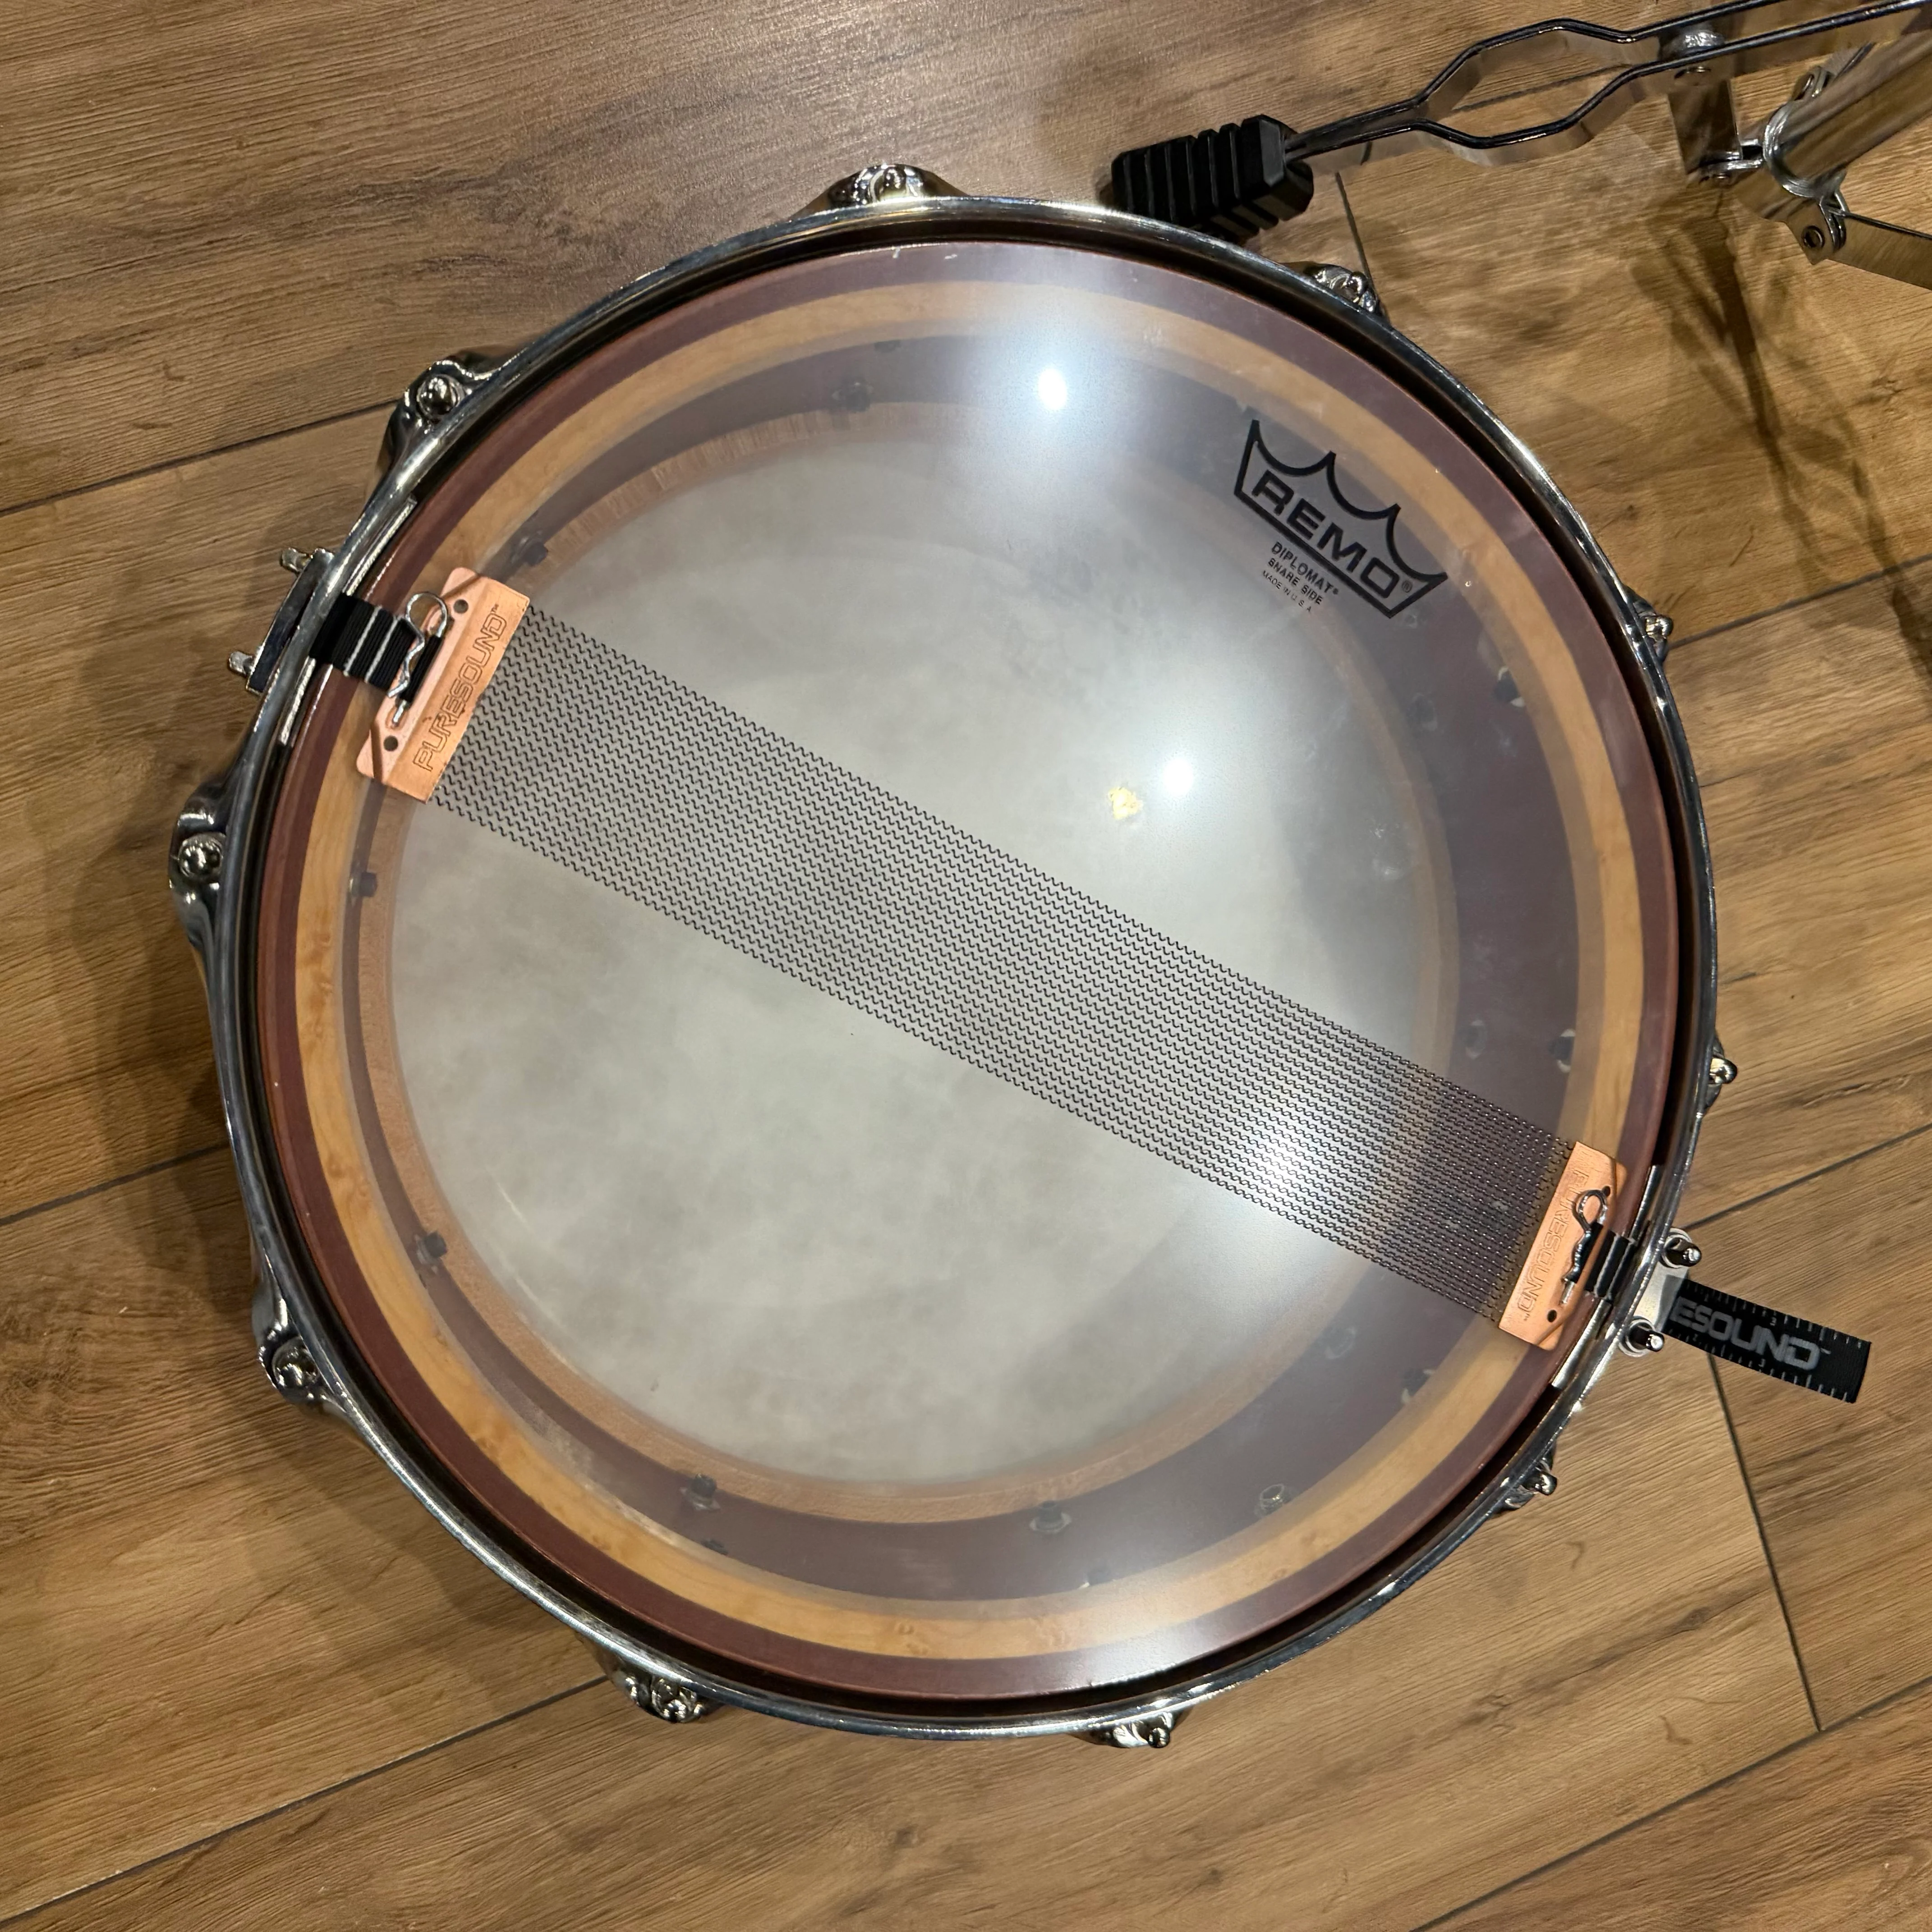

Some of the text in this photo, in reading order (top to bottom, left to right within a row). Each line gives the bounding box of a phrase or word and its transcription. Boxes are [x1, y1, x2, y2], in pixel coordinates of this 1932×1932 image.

[1263, 570, 1282, 589] MADE
[1283, 587, 1291, 596] IN
[1268, 557, 1324, 605] SNARE SIDE
